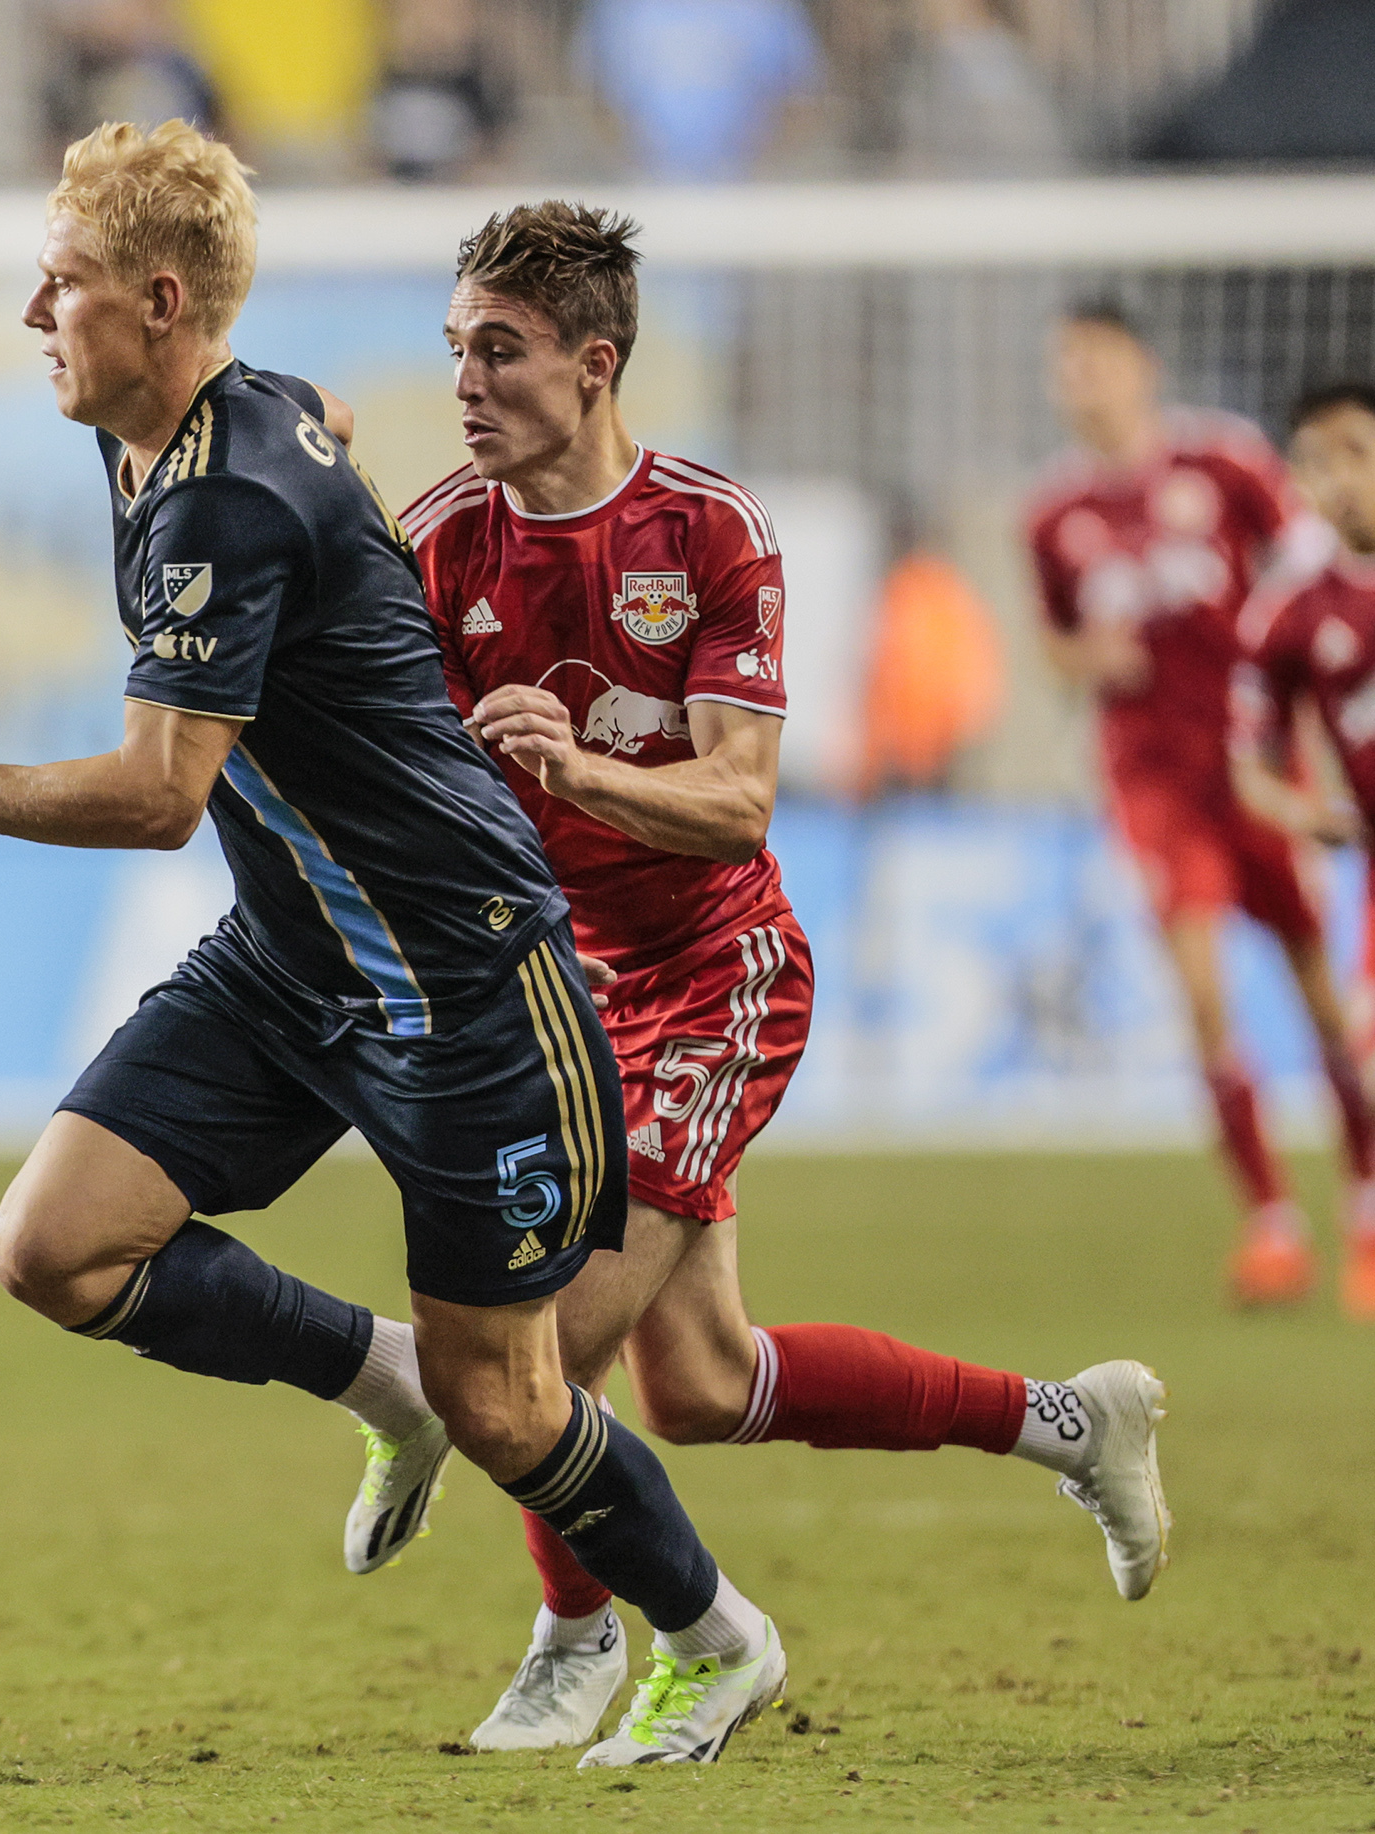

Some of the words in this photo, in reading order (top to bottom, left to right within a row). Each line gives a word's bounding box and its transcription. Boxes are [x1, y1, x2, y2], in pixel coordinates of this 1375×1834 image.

[167, 567, 193, 580] MLS
[629, 579, 654, 592] Red
[656, 579, 680, 592] Bull
[761, 590, 777, 603] MLS
[632, 618, 652, 636] NEW
[655, 617, 679, 637] YORK
[179, 630, 218, 662] tv
[653, 1037, 728, 1123] 5
[497, 1132, 562, 1228] 5
[508, 1246, 547, 1270] adidas
